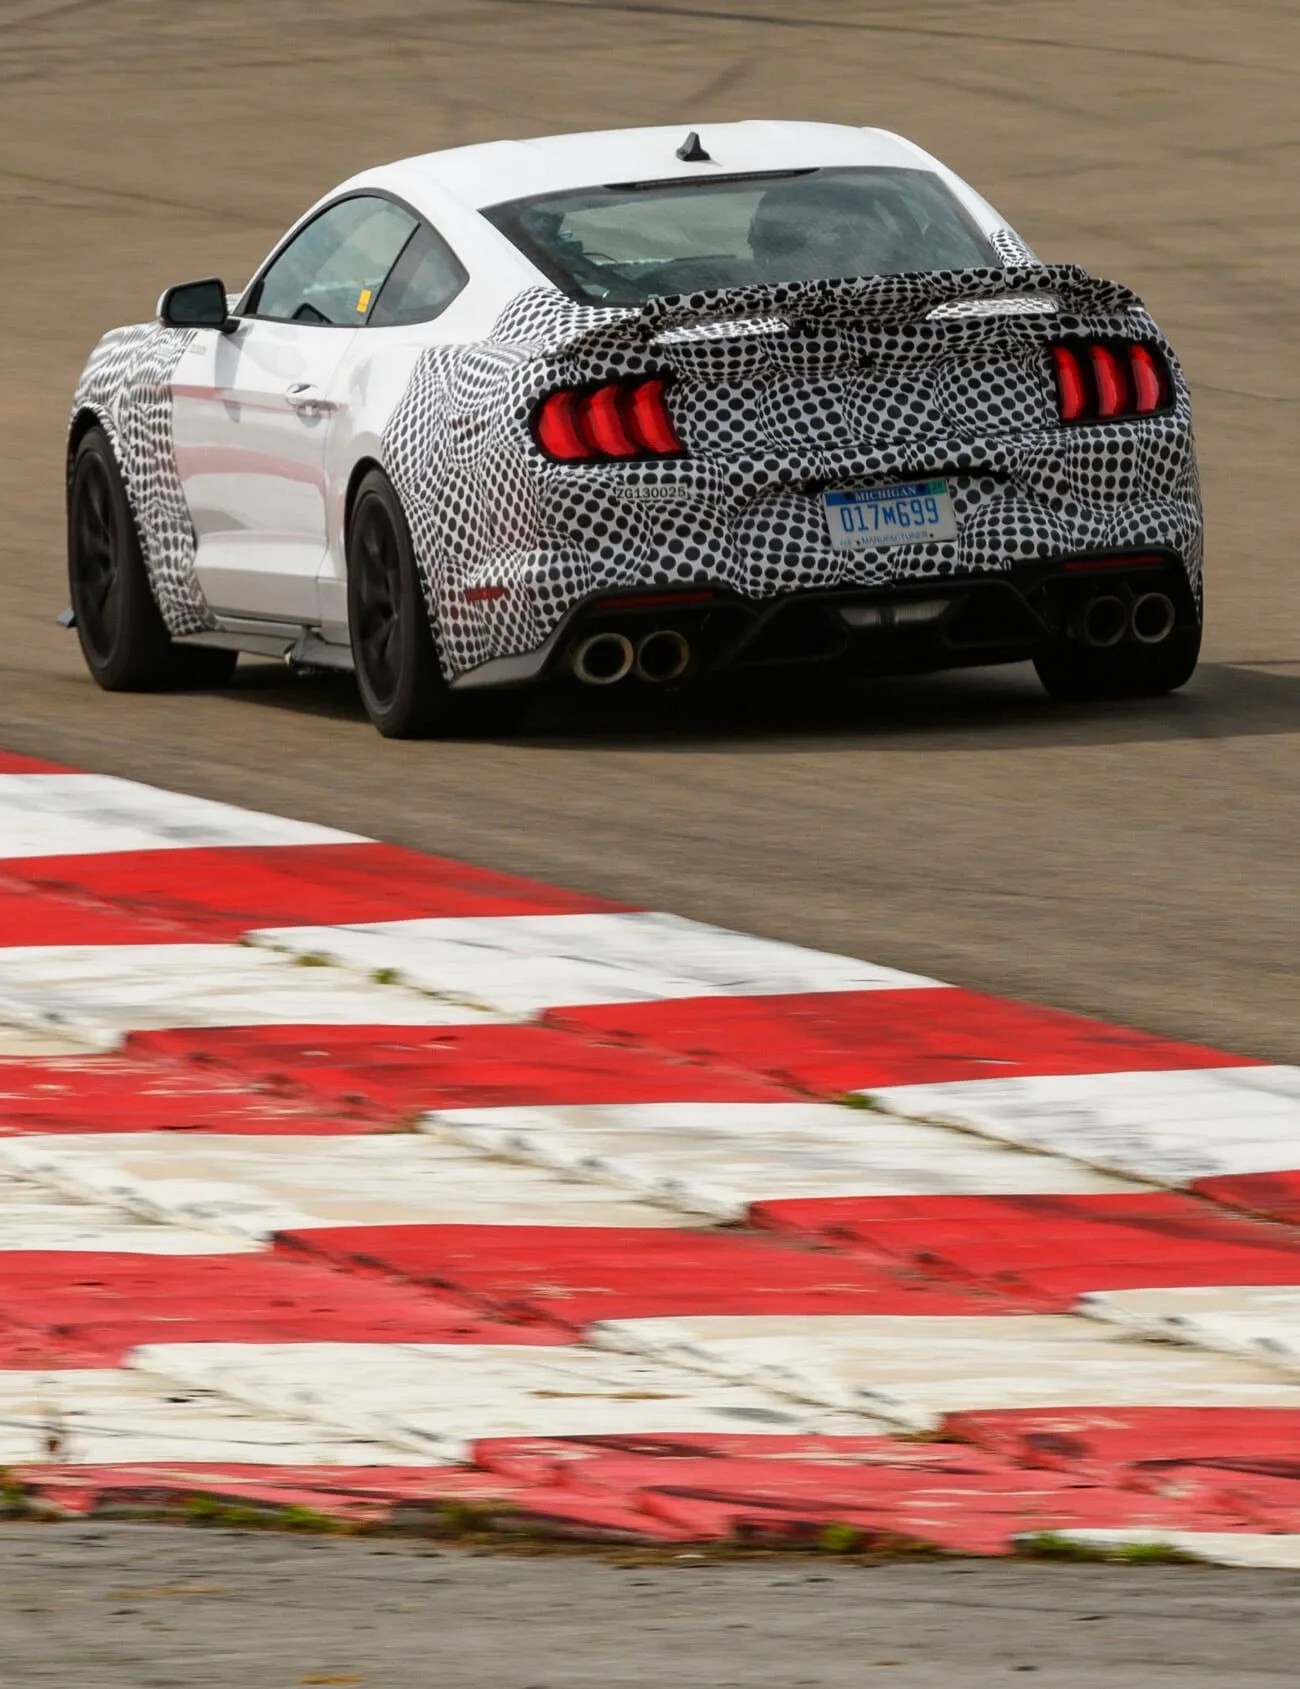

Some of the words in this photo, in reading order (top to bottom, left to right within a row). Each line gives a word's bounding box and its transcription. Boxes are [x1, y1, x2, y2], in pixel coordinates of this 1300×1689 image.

[616, 486, 686, 499] ZG130025
[855, 486, 916, 501] MICHIGAN
[840, 497, 939, 532] 017M699
